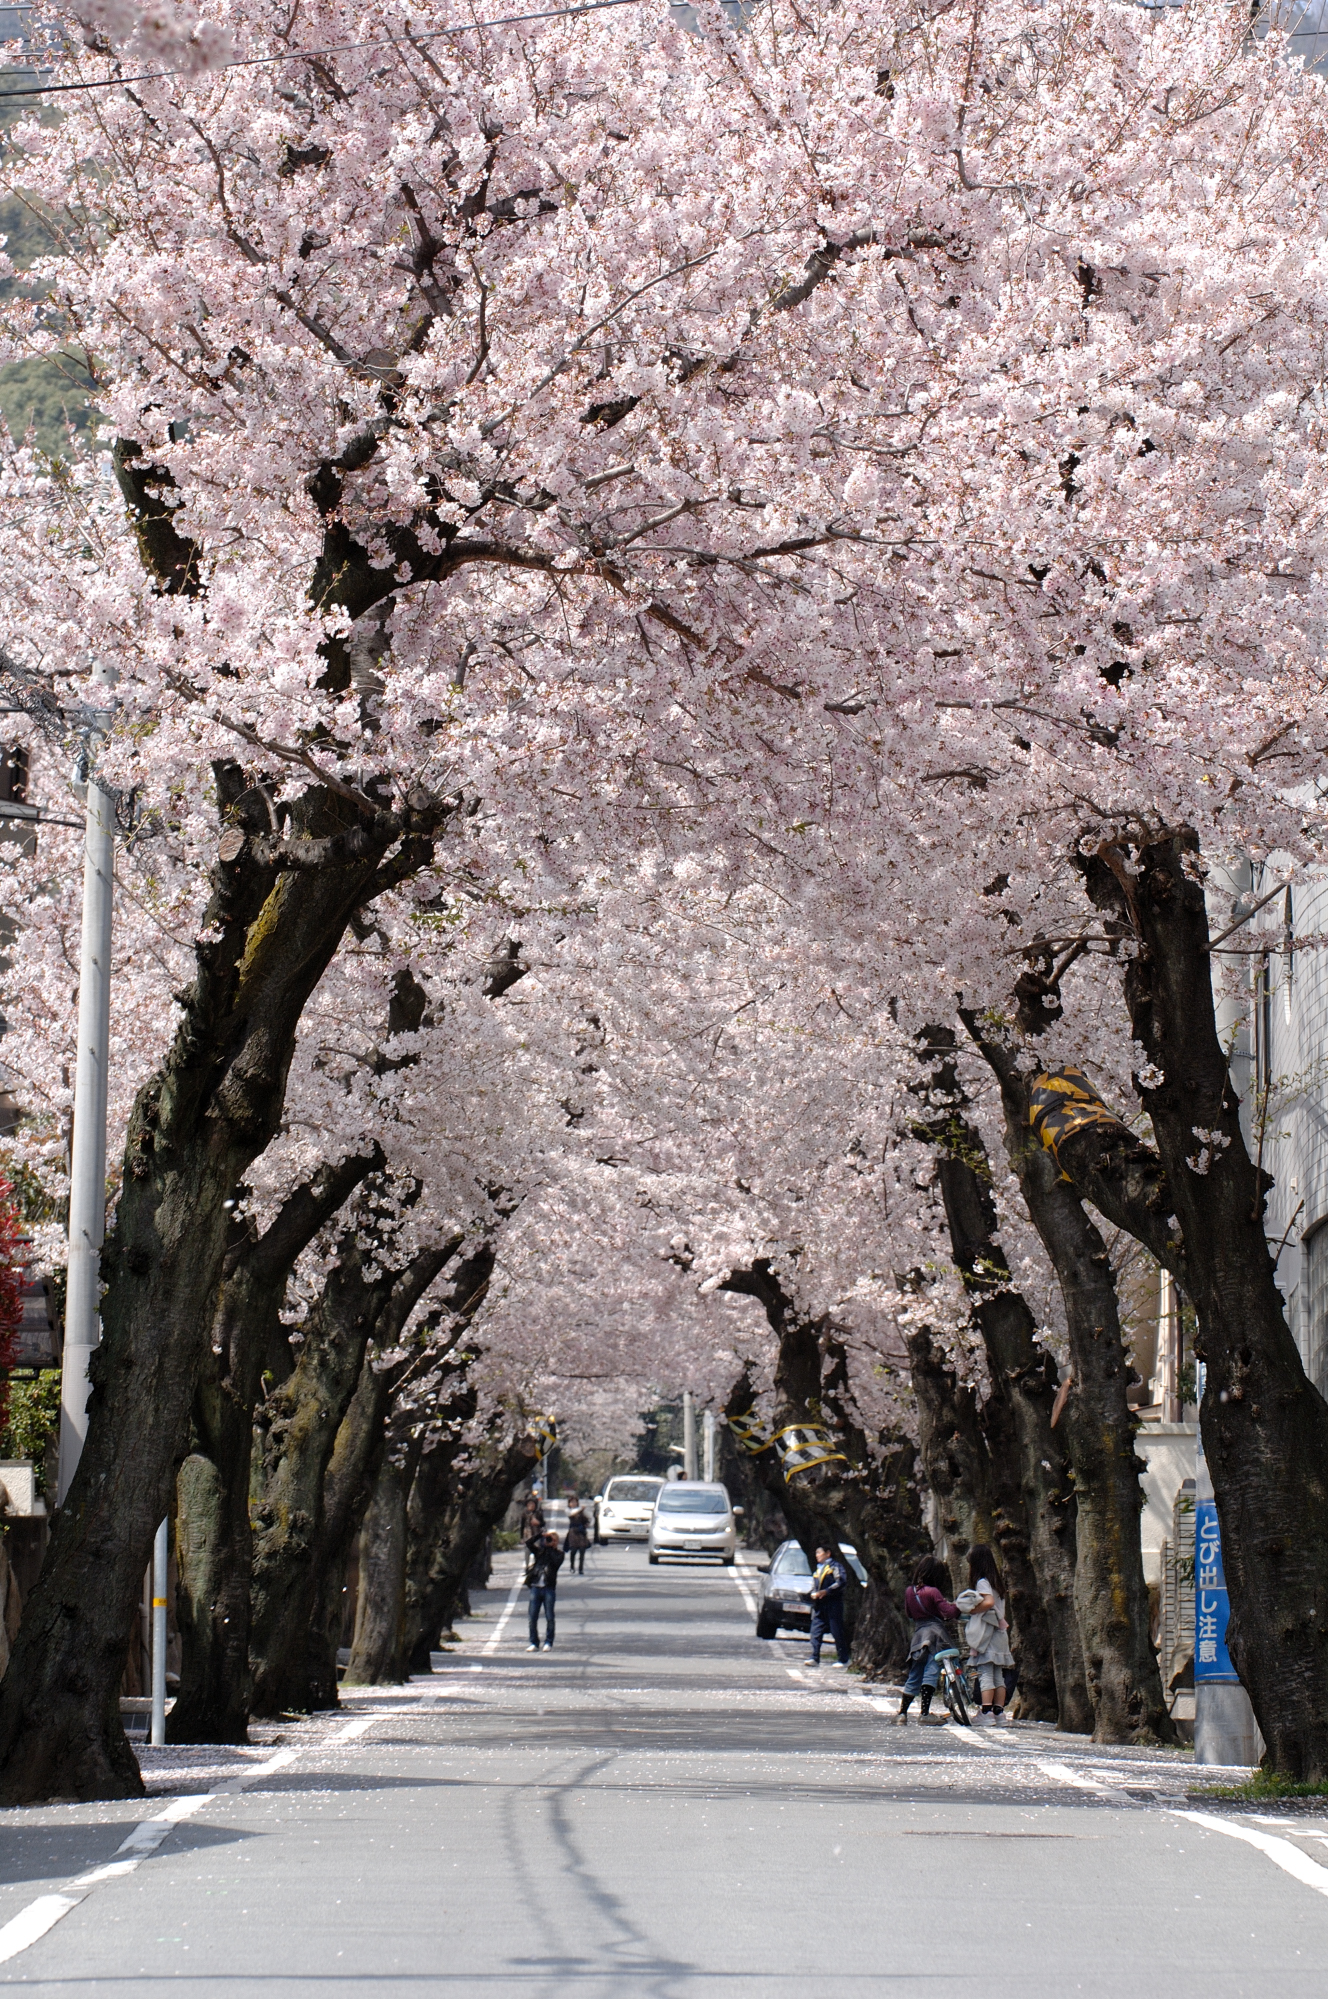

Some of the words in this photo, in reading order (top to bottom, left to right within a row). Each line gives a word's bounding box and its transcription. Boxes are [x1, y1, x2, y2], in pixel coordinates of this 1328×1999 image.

[1198, 1515, 1220, 1662] とび出し注意
